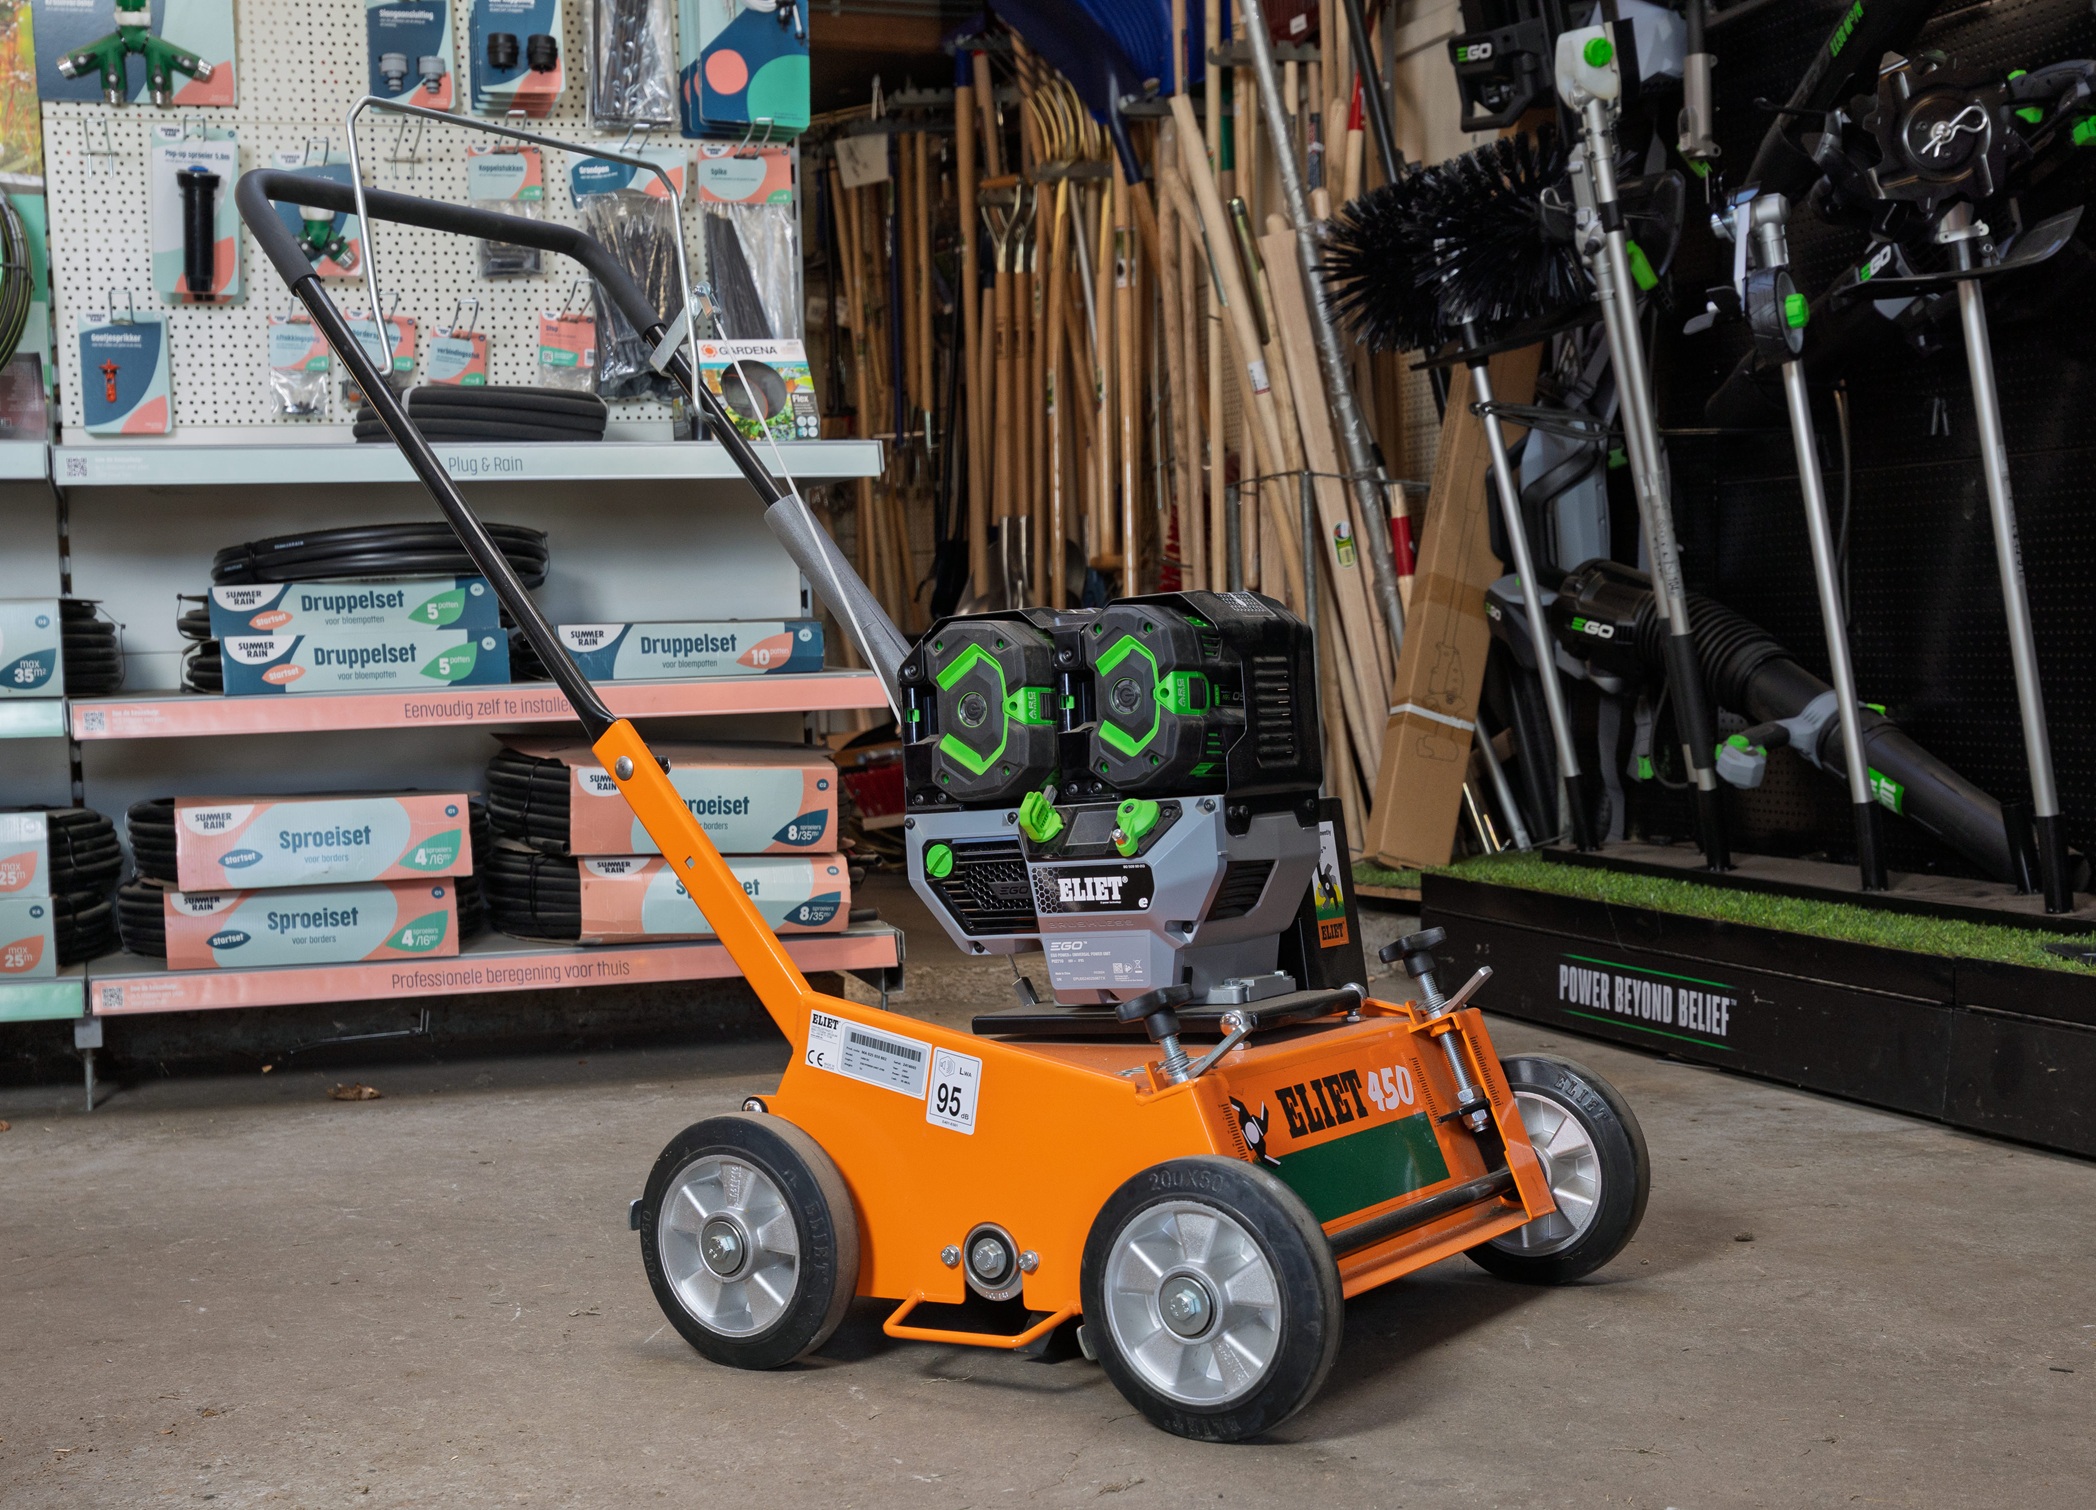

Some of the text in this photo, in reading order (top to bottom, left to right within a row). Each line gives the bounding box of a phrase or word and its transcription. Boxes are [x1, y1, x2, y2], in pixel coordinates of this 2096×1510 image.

[1457, 43, 1492, 62] EGO
[1861, 245, 1891, 281] EGO
[792, 394, 809, 403] Flex
[448, 456, 523, 476] Plug & Rain
[226, 590, 262, 599] SUMMER
[234, 597, 255, 606] RAIN
[301, 590, 404, 615] Druppelset
[427, 603, 438, 619] 5
[255, 613, 286, 626] Startset
[325, 615, 385, 626] voor bloempotten
[571, 630, 604, 639] SUMMER
[1571, 617, 1614, 639] EGO
[238, 641, 275, 651] SUMMER
[578, 638, 598, 646] RAIN
[640, 633, 737, 657] Druppelset
[247, 648, 268, 658] RAIN
[314, 643, 416, 668] Druppelset
[752, 649, 770, 665] 10
[20, 660, 39, 669] max
[439, 658, 450, 675] 5
[678, 659, 718, 669] bloempotten
[268, 666, 299, 681] Startset
[337, 669, 397, 680] voor bloempotten
[404, 700, 473, 720] Eenvoudig
[477, 698, 500, 716] zelf
[504, 699, 517, 715] te
[597, 782, 617, 790] RAIN
[195, 812, 232, 822] SUMMER
[203, 820, 225, 830] RAIN
[703, 821, 728, 830] borders
[279, 825, 371, 852] Sproeiset
[788, 825, 798, 840] 8
[224, 852, 256, 865] Startset
[322, 853, 349, 863] borders
[415, 848, 427, 865] 4
[1000, 886, 1028, 895] EGO
[184, 895, 220, 905] SUMMER
[192, 903, 213, 912] RAIN
[799, 906, 810, 921] 8
[267, 907, 359, 934] Sproeiset
[402, 929, 414, 946] 4
[1321, 922, 1345, 941] ELIET
[212, 933, 244, 946] Startset
[309, 935, 336, 944] borders
[8, 947, 27, 955] max
[392, 959, 630, 989] Professionele beregening voor thuis
[1559, 964, 1610, 1010] POWER
[1615, 975, 1672, 1024] BEYOND
[812, 1013, 839, 1030] ELIET
[936, 1083, 962, 1117] 95
[1275, 1065, 1414, 1139] ELIET 450
[1554, 1073, 1609, 1123] ELIET
[961, 1113, 970, 1121] dB
